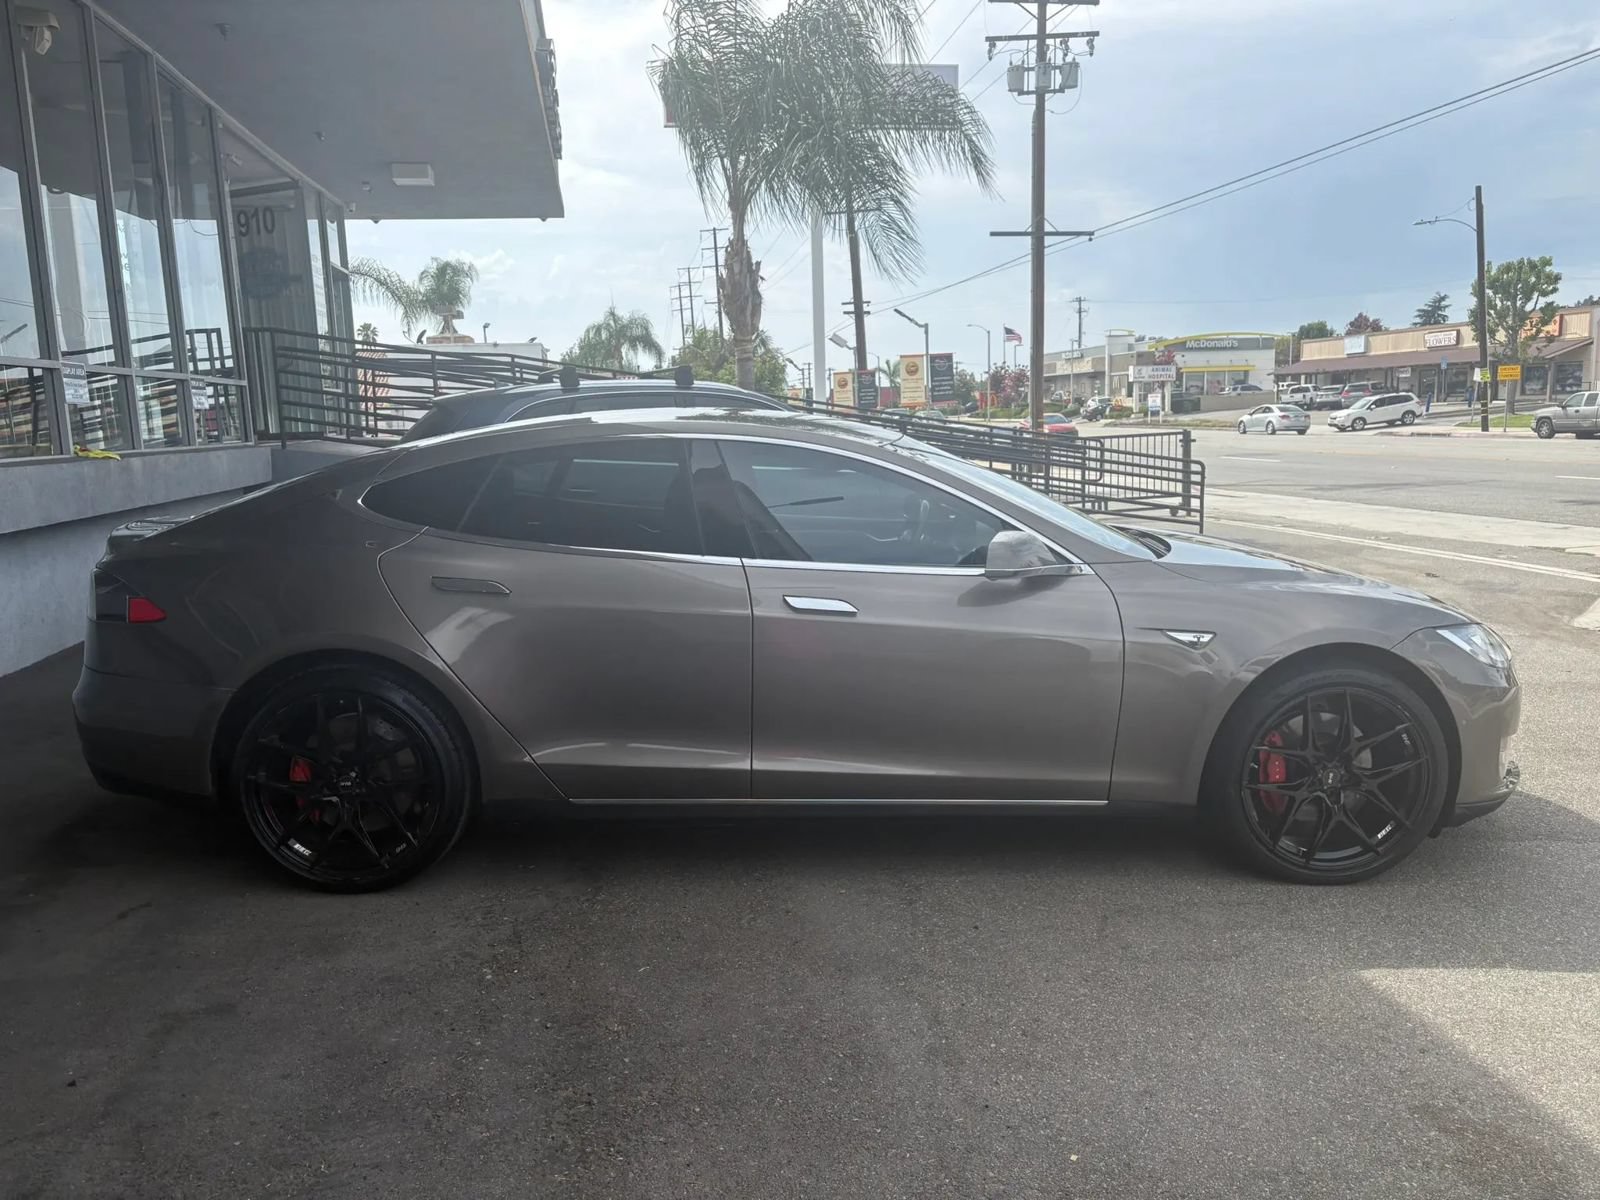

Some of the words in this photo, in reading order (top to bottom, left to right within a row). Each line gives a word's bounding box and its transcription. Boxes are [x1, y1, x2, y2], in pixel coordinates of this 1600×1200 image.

[237, 206, 275, 237] 910
[1185, 338, 1239, 349] McDonald's
[1425, 335, 1457, 346] FLOWERS
